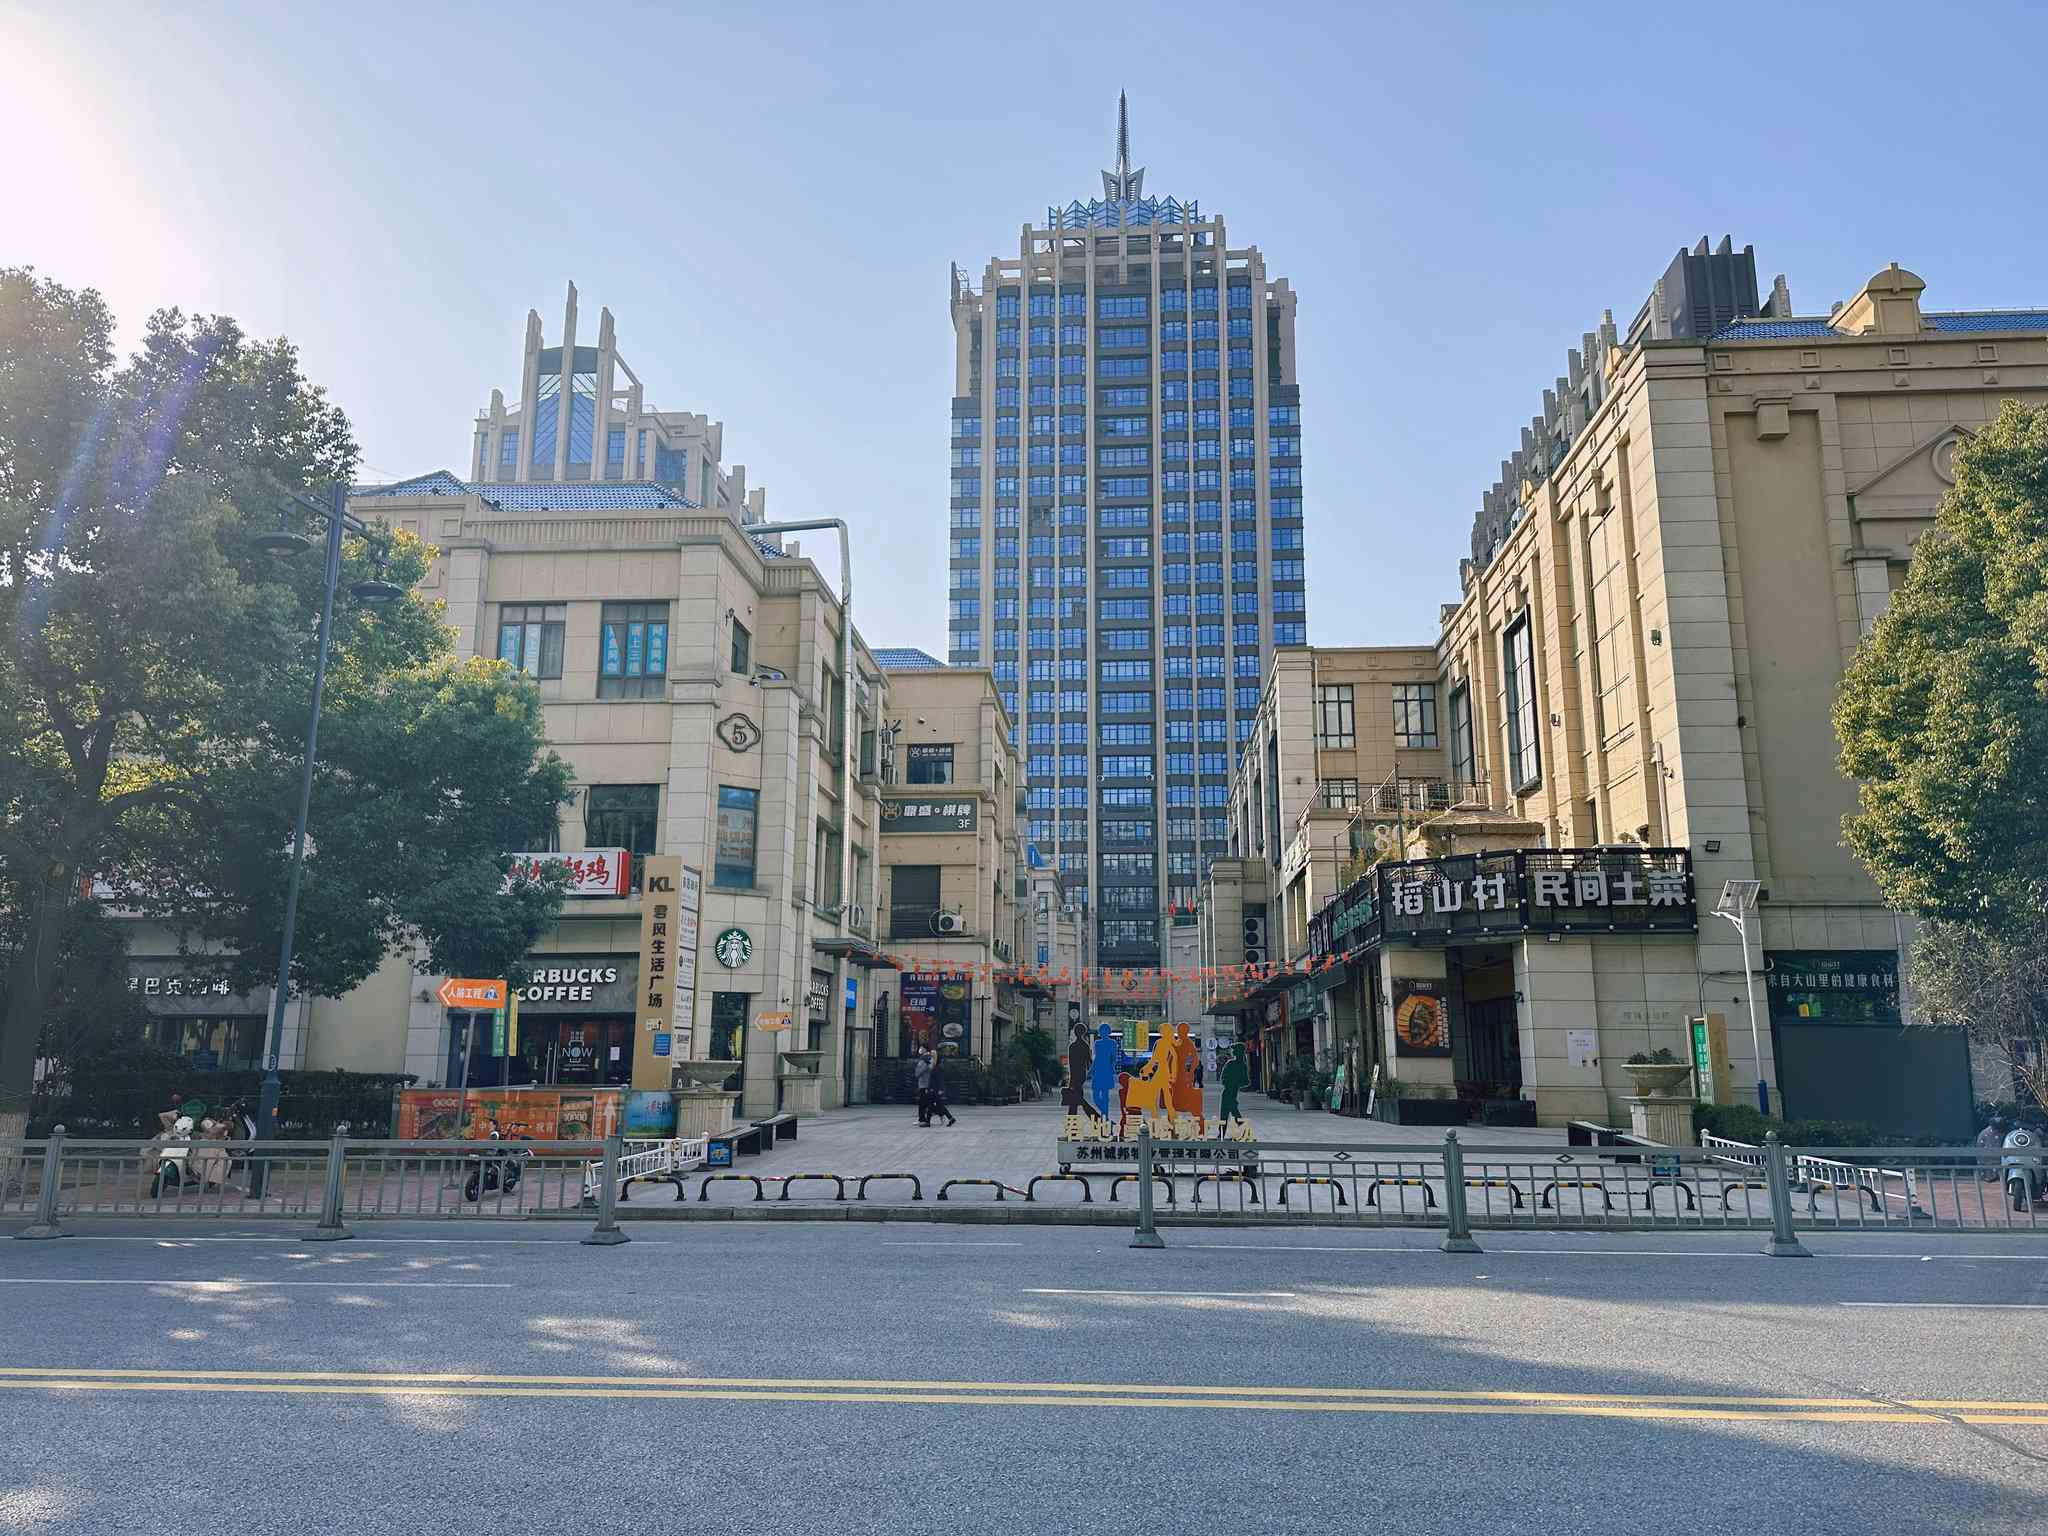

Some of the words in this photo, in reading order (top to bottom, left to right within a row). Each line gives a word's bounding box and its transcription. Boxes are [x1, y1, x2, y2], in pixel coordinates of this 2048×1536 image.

[732, 723, 748, 745] 5
[957, 819, 971, 829] 3F
[1534, 871, 1688, 907] 民间土菜
[516, 986, 593, 1001] COFFEE
[561, 1047, 593, 1058] NOW
